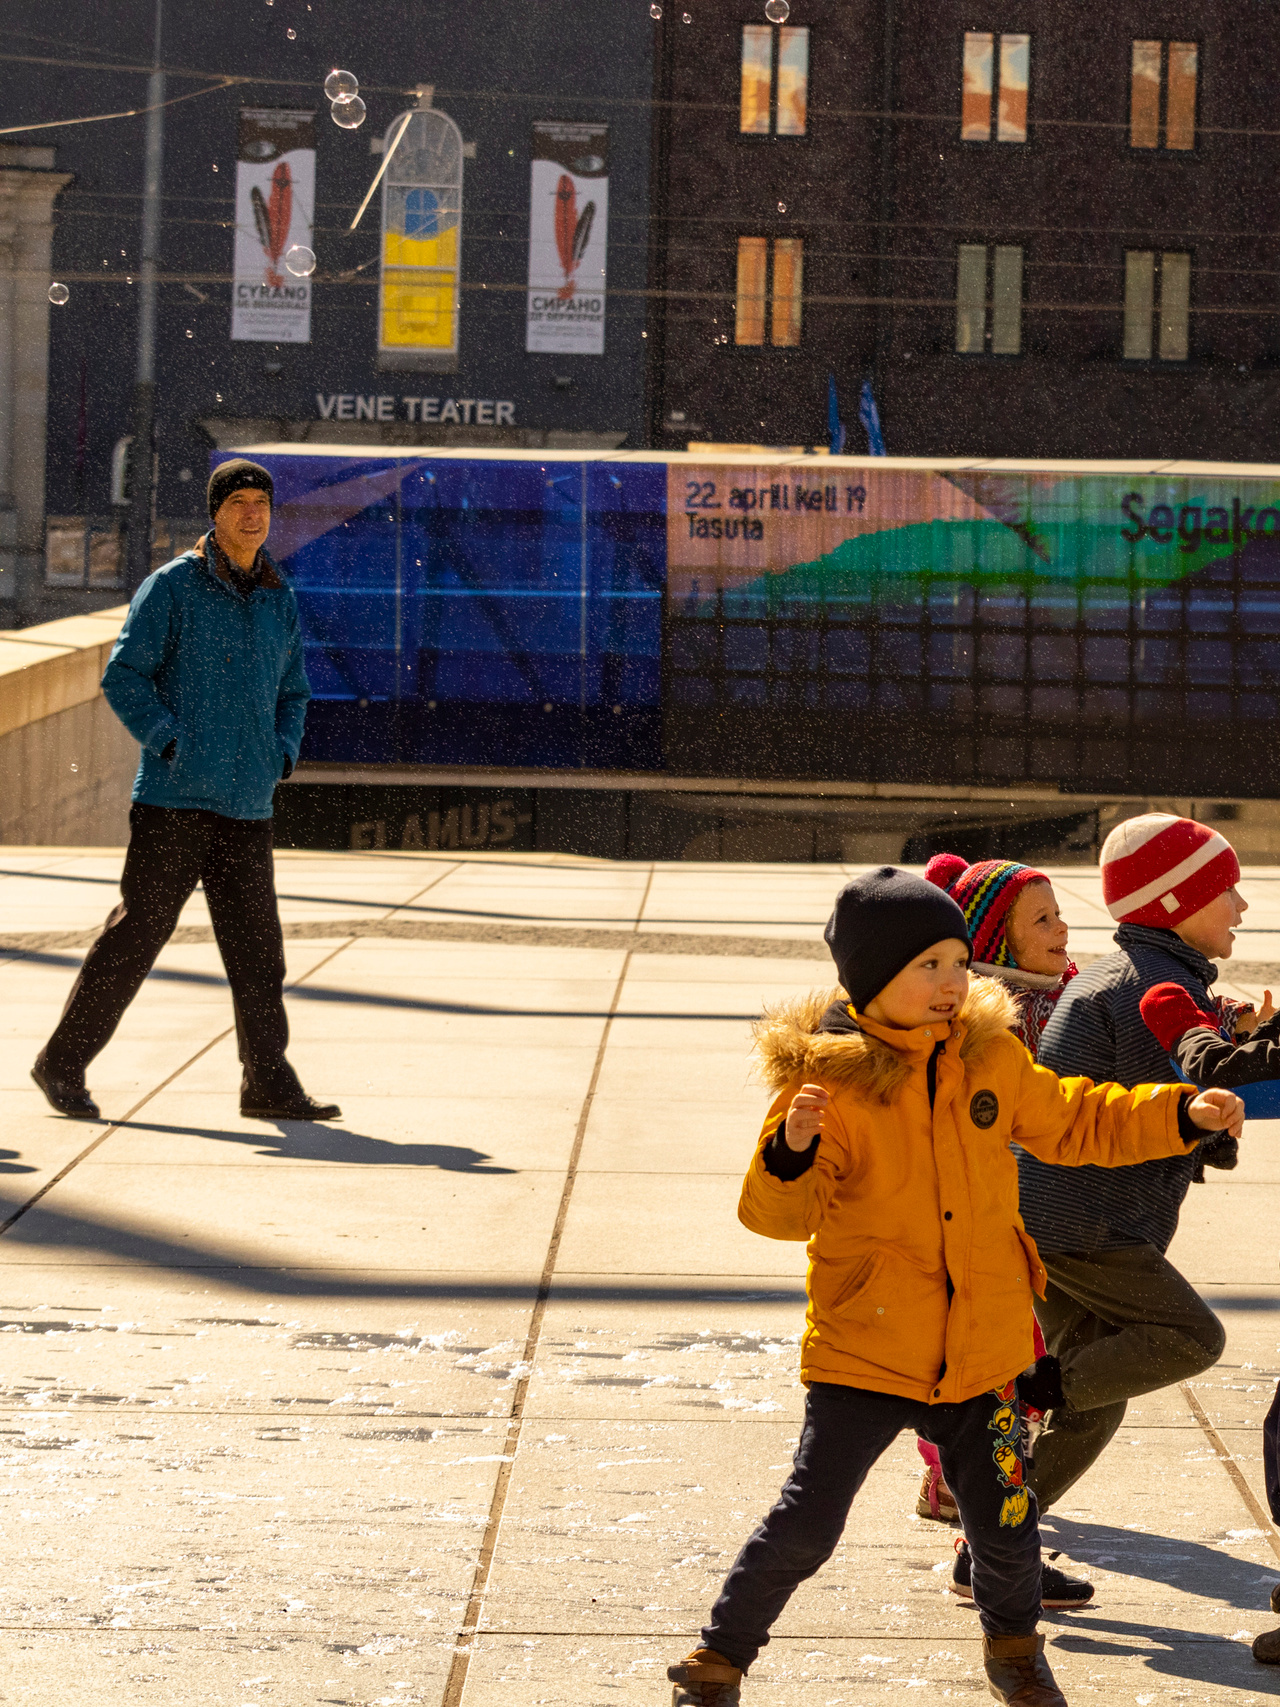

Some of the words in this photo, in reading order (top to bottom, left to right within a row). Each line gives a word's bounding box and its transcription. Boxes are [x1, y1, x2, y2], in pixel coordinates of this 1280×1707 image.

[237, 282, 307, 300] CYRANO
[532, 296, 601, 313] СИРАНО
[316, 393, 395, 421] VENE
[403, 397, 517, 426] TEATER
[729, 484, 789, 512] aprill
[795, 484, 838, 511] kell
[846, 485, 867, 512] 19
[685, 511, 764, 541] Tasuta
